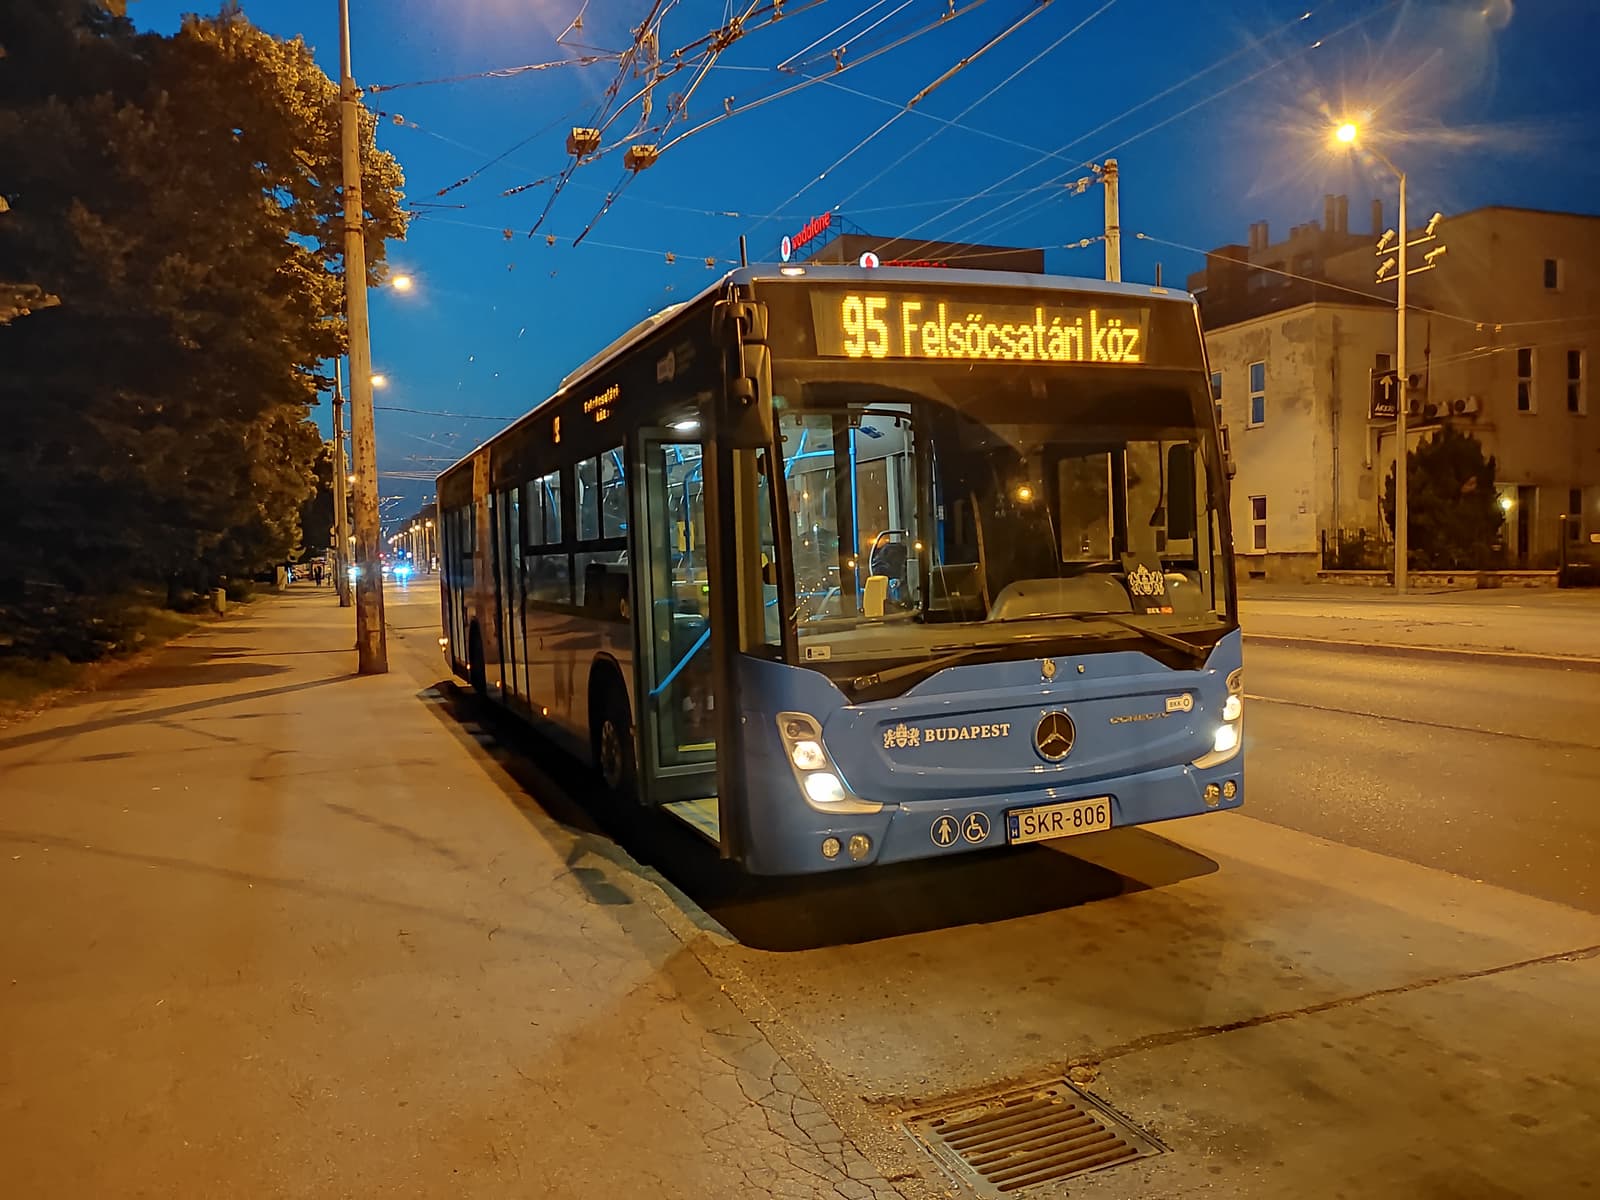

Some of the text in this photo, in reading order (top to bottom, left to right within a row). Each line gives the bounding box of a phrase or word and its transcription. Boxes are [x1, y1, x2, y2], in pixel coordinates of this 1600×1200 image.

[791, 211, 831, 250] vodafone
[842, 295, 1140, 362] 95 Felsőcsatári köz
[924, 723, 1011, 743] BUDAPEST
[1024, 804, 1106, 835] SKR-806
